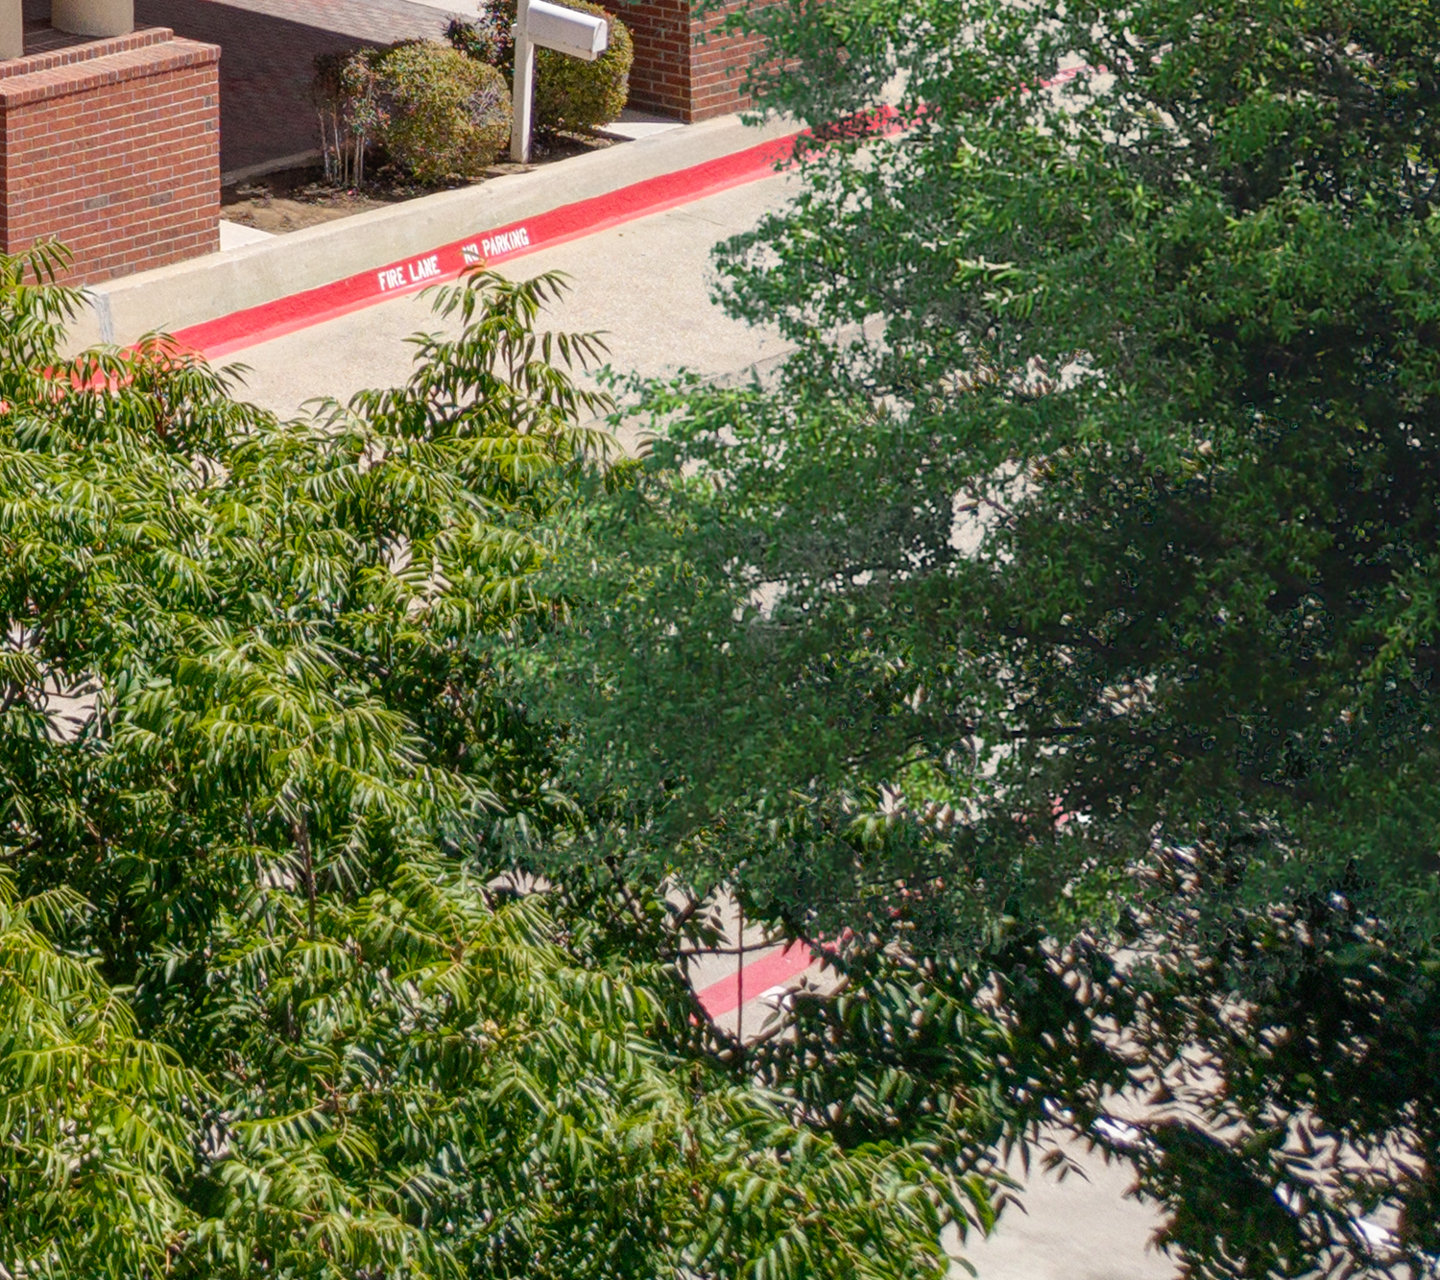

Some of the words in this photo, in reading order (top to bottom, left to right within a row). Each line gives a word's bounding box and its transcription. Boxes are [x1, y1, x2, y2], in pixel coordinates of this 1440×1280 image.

[378, 266, 406, 291] FIRE
[408, 255, 441, 281] LANE
[462, 243, 480, 264] NO
[482, 227, 529, 257] PARKING
